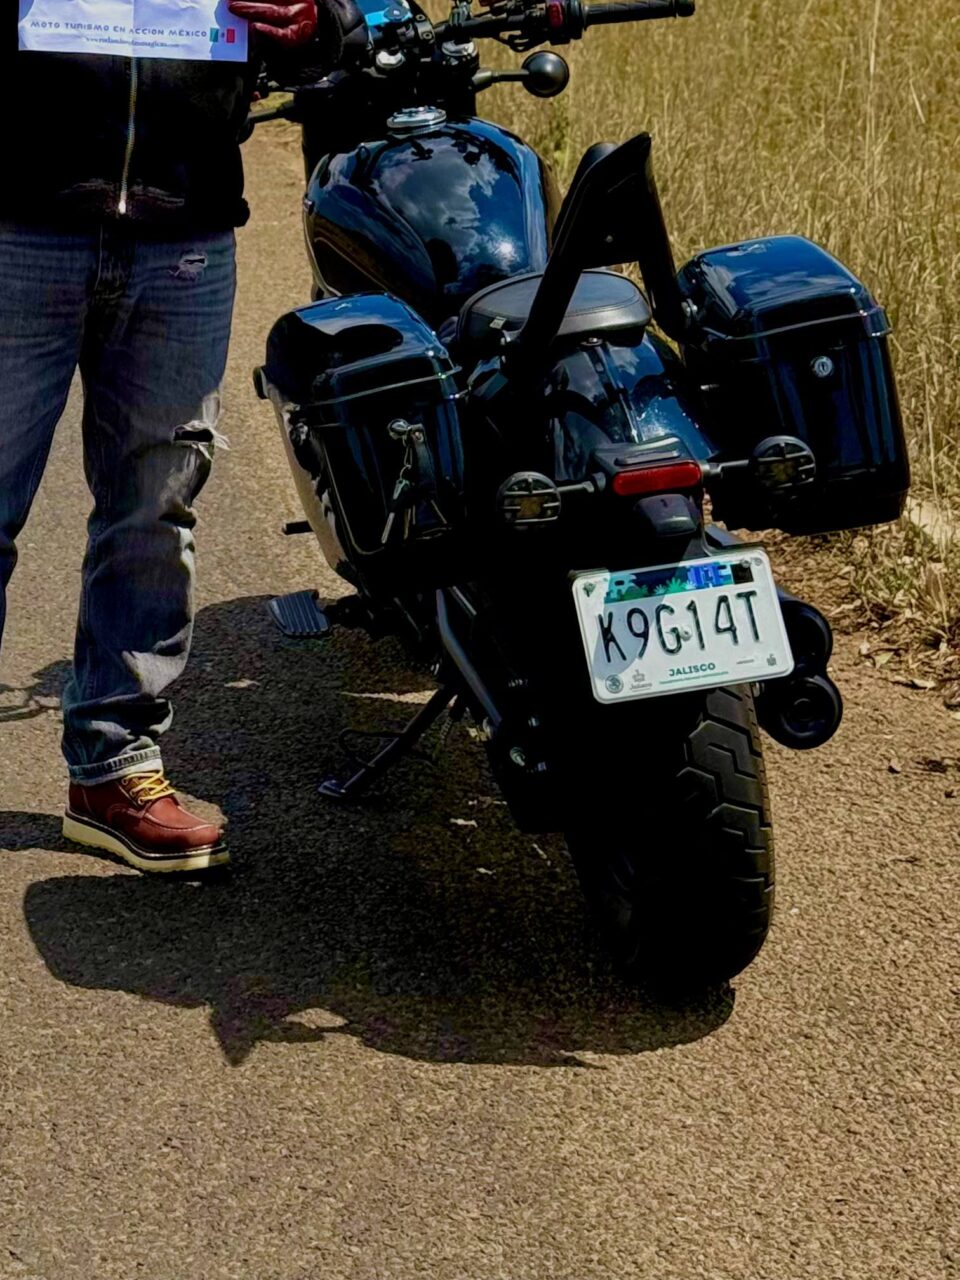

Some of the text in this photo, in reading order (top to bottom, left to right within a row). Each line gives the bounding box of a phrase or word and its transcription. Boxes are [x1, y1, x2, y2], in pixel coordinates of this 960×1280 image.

[30, 21, 61, 29] MOTO
[65, 23, 110, 32] TURISMO
[597, 590, 761, 663] K9G14T
[668, 662, 717, 677] JALISCO
